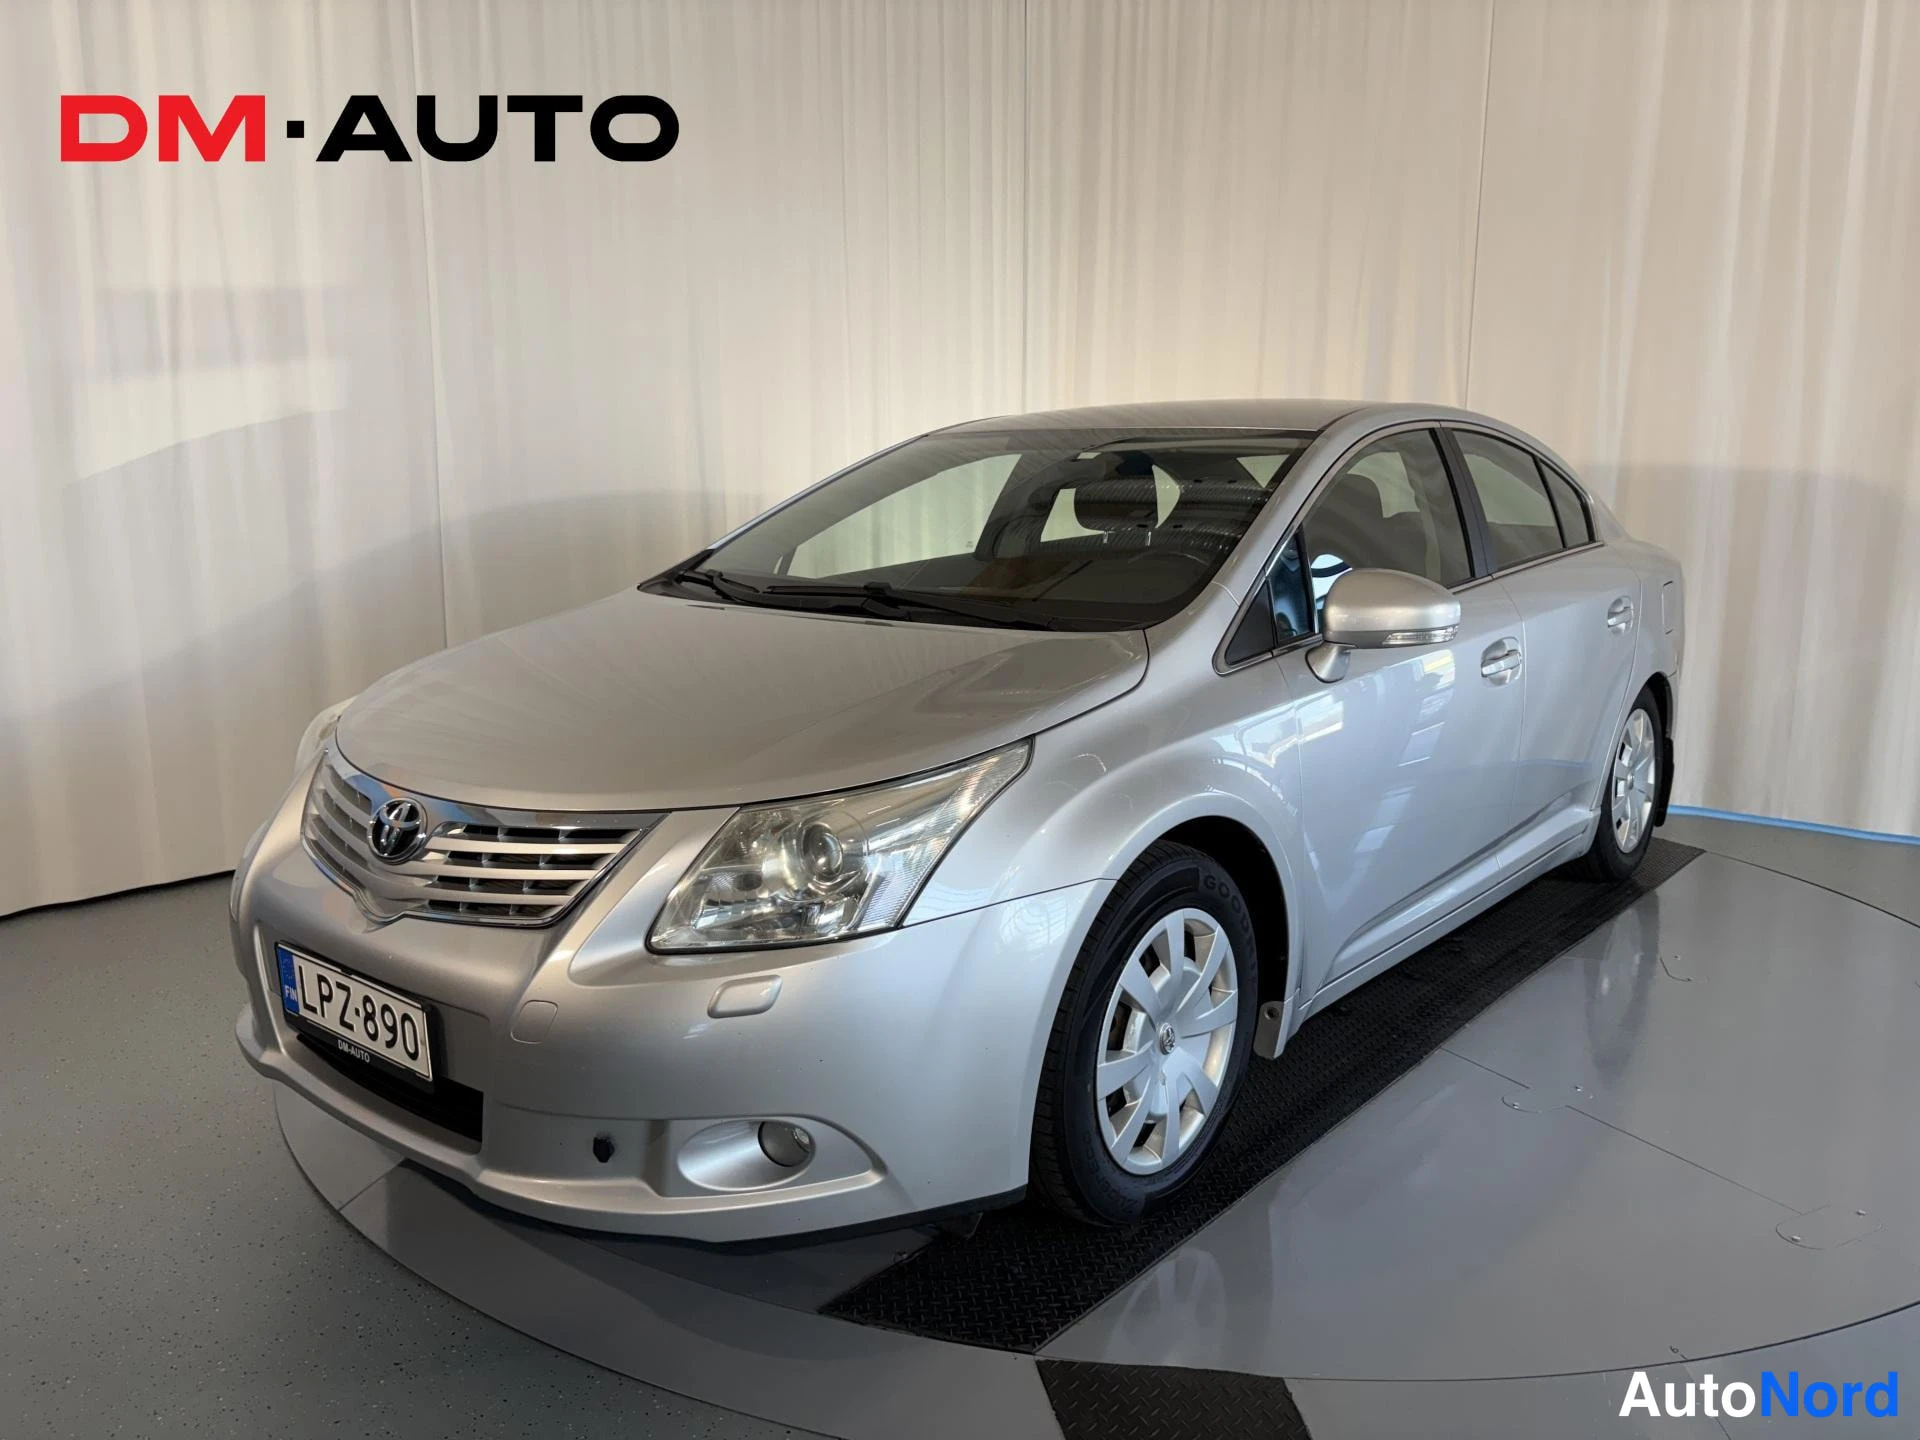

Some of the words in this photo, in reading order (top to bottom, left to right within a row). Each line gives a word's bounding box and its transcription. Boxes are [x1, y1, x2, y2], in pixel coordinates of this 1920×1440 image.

[284, 985, 298, 1001] FIN
[298, 965, 420, 1061] LPZ-890
[337, 1039, 370, 1063] DM-AUTO
